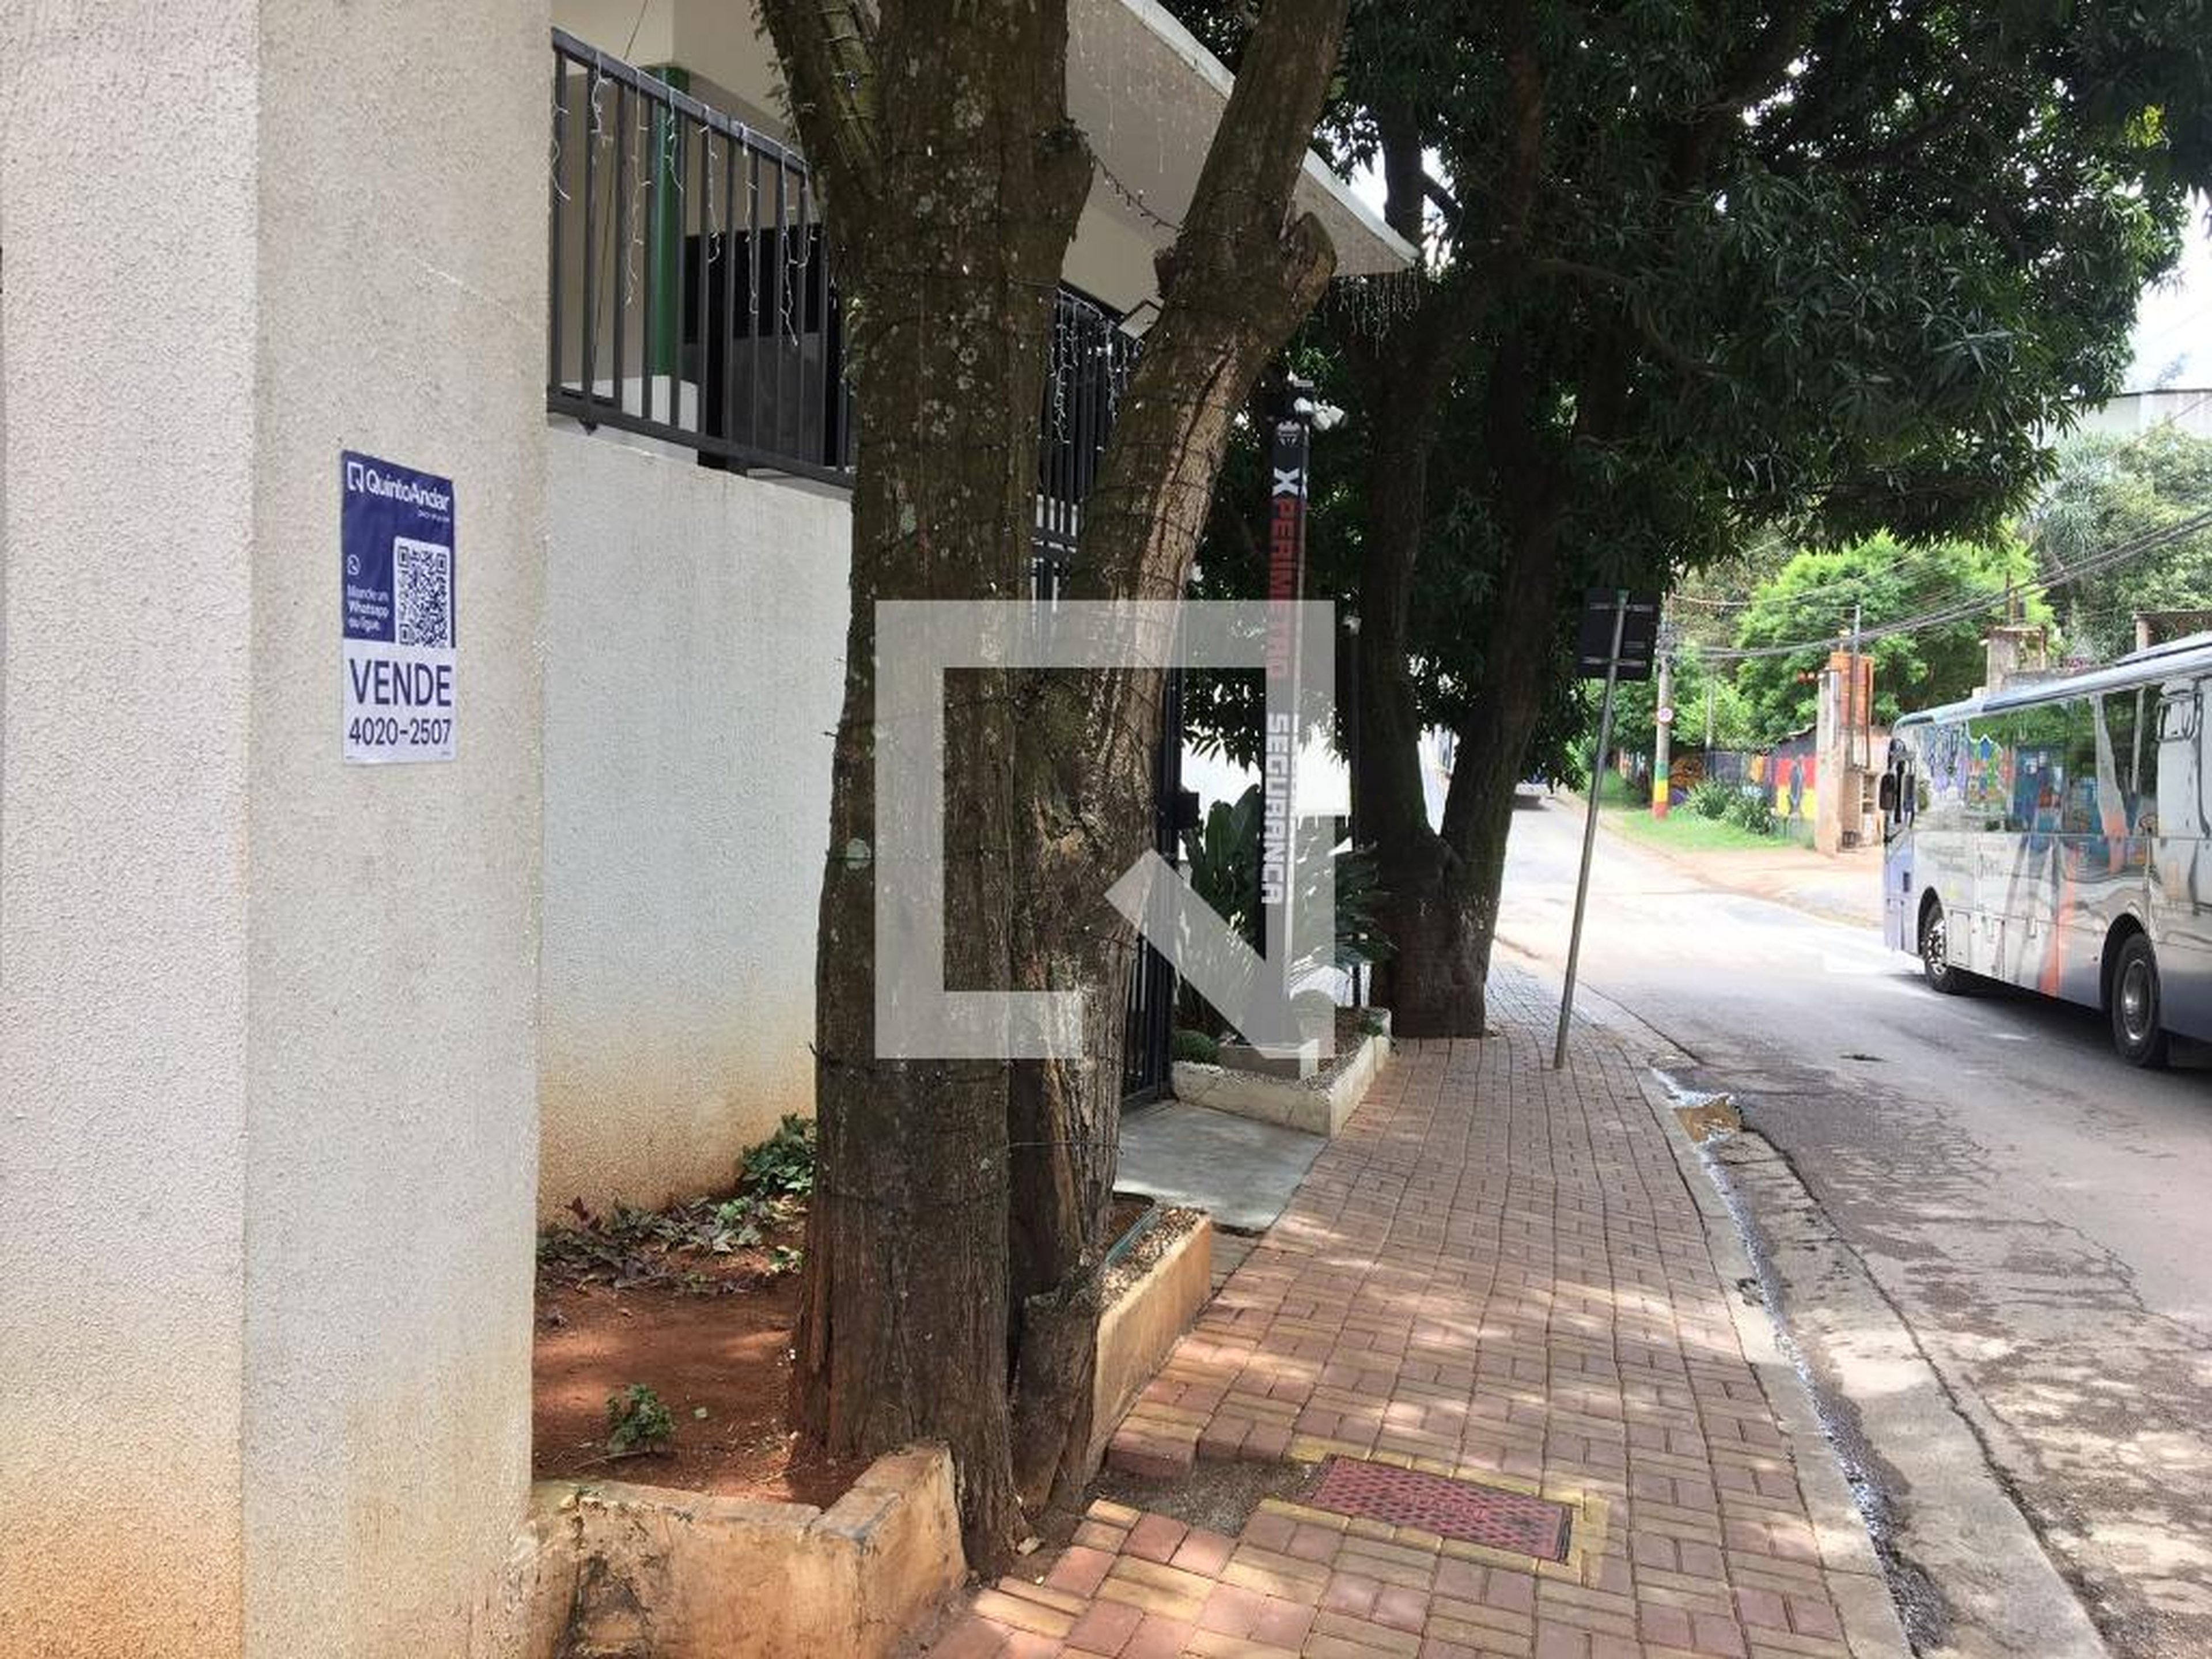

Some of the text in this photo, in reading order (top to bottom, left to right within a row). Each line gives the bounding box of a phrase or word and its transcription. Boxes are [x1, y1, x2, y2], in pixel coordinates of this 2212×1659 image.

[366, 468, 450, 512] QuintoAndar
[350, 658, 452, 707] VENDE
[349, 717, 452, 746] 4020-2507
